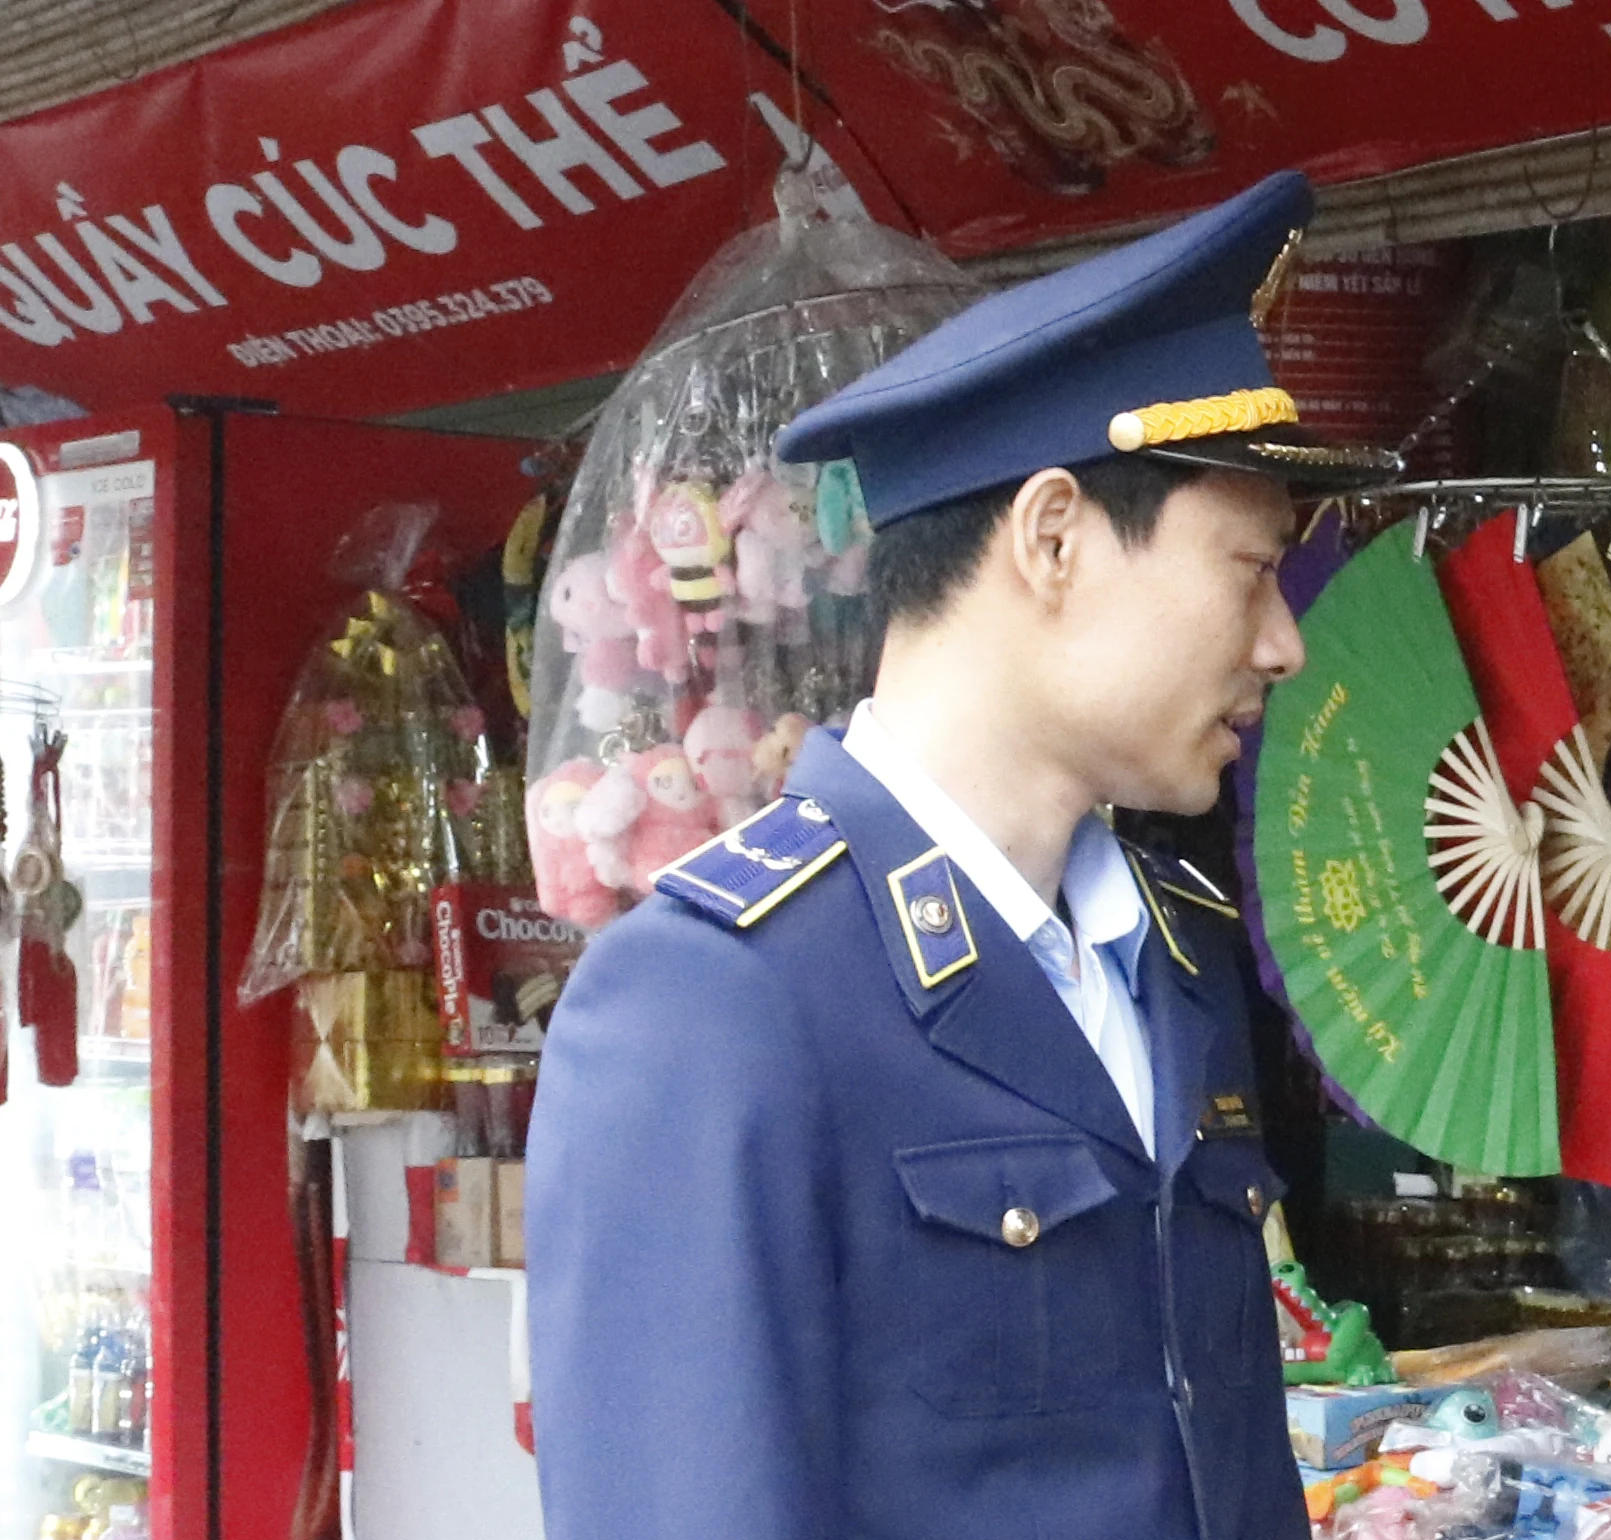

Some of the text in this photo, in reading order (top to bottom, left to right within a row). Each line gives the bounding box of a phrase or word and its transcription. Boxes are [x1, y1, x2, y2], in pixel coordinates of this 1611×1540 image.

[204, 136, 458, 288] CÚC
[410, 15, 728, 231] THỂ
[226, 333, 297, 368] ĐIỆN
[372, 275, 554, 336] 0395.324.379
